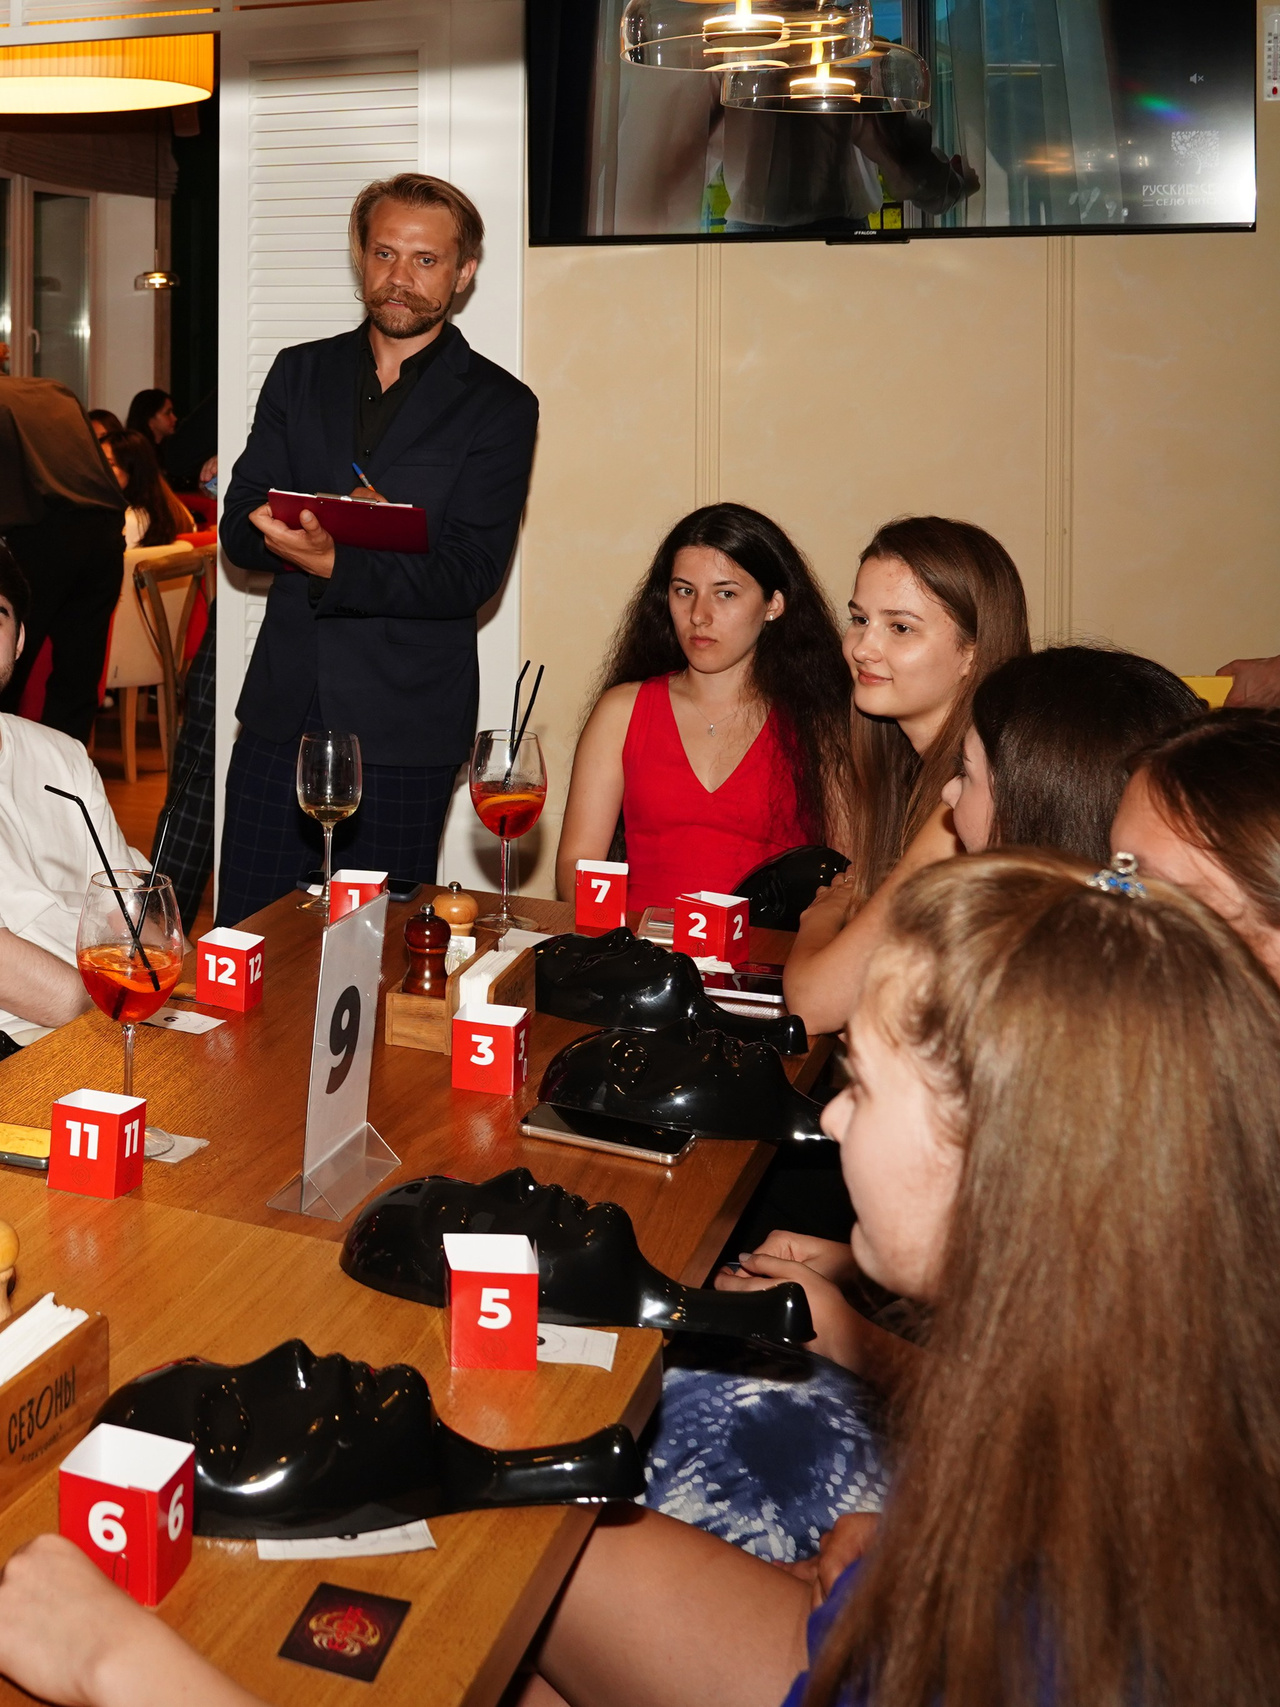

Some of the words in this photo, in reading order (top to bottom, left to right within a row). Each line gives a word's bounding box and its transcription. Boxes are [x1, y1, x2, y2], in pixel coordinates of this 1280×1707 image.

[1155, 198, 1185, 206] СЕЛО
[347, 888, 360, 911] 1
[590, 878, 611, 904] 7
[687, 912, 708, 940] 2
[732, 914, 743, 941] 2
[204, 952, 237, 987] 12
[248, 952, 262, 985] 12
[325, 985, 362, 1096] 9
[469, 1033, 495, 1066] 3
[65, 1118, 100, 1161] 11
[124, 1118, 140, 1159] 11
[477, 1287, 512, 1330] 5
[8, 1364, 76, 1455] СЕЗОНЫ
[87, 1500, 128, 1553] 6
[166, 1482, 185, 1543] 6
